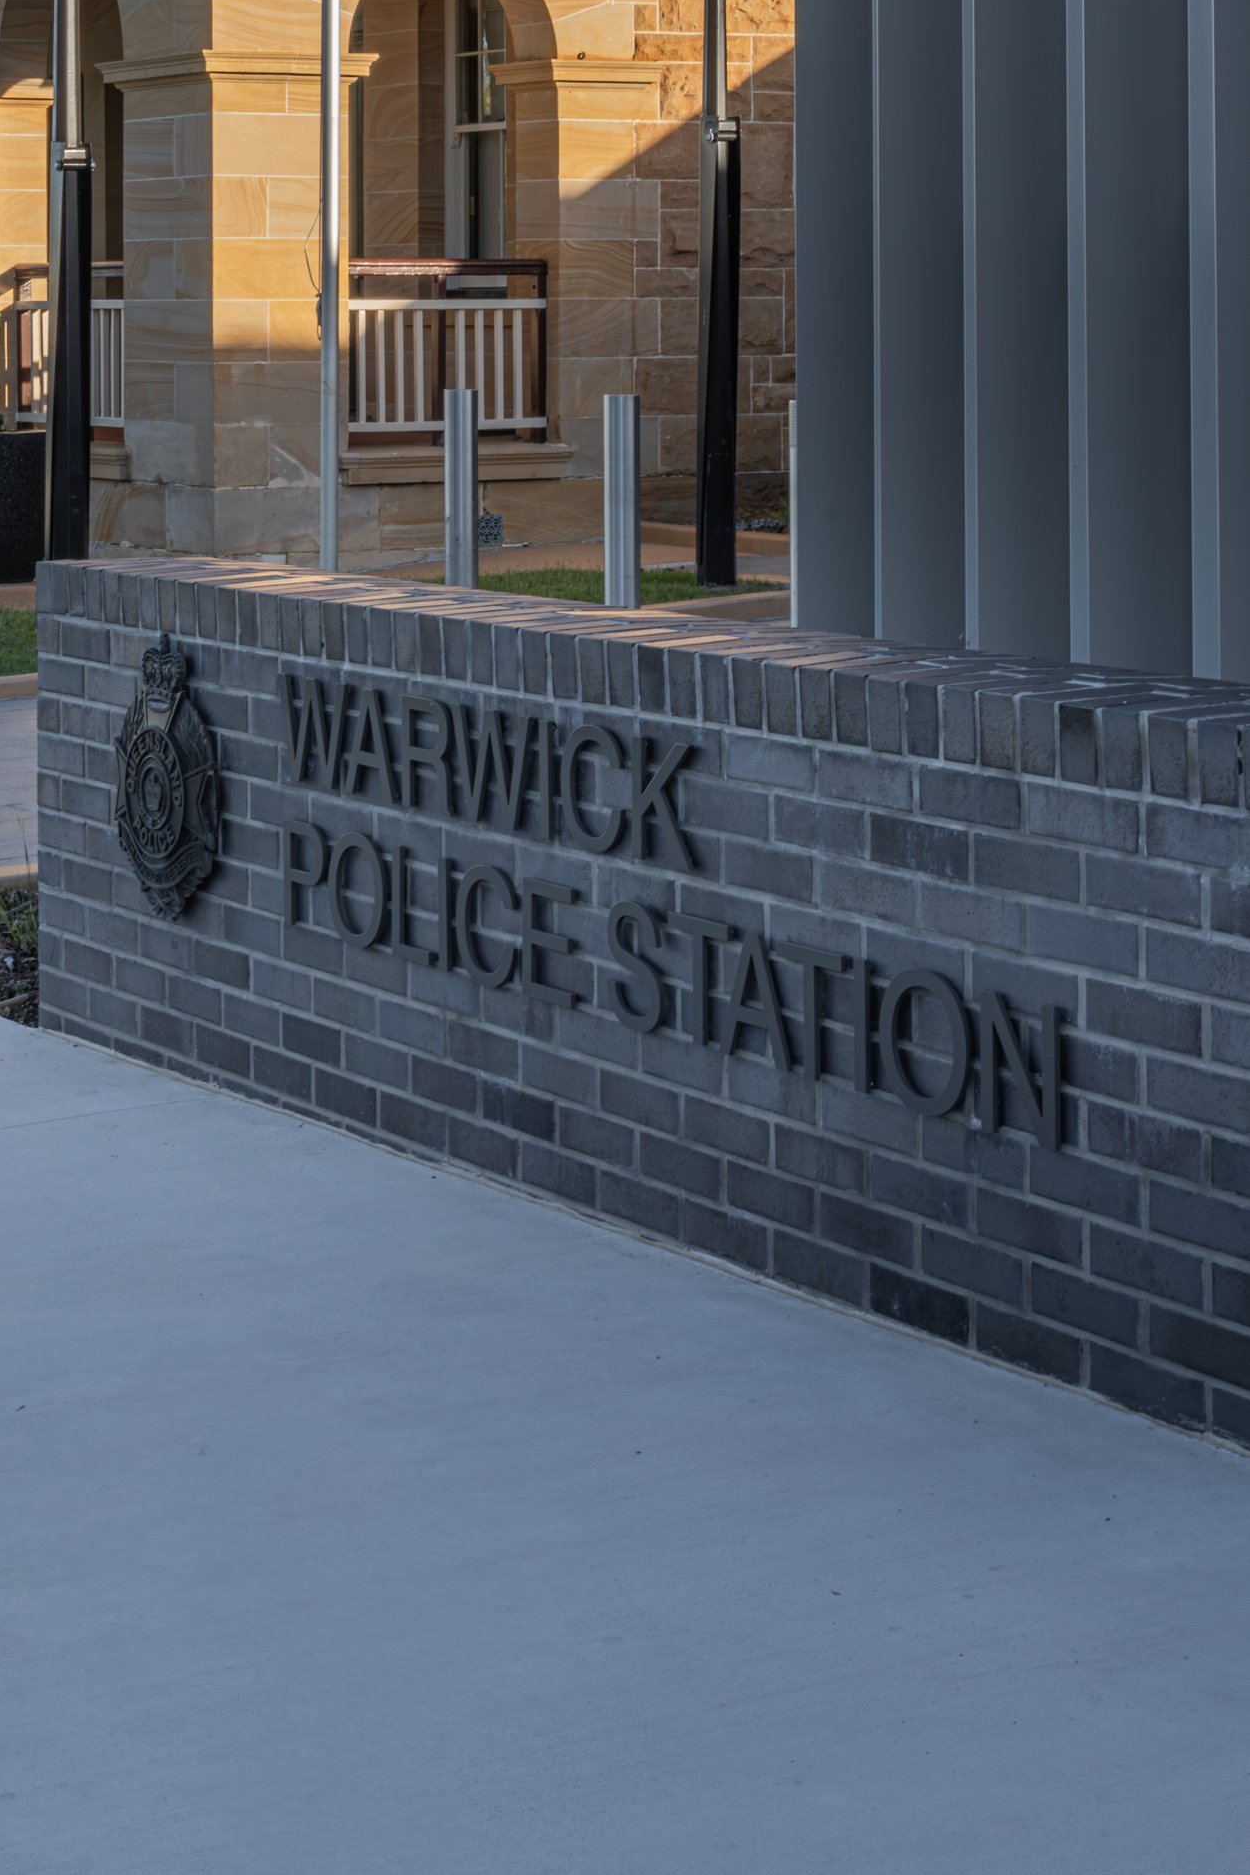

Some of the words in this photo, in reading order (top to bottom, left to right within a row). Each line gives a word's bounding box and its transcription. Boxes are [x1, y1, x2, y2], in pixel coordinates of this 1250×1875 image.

[126, 732, 181, 808] QUEENSLAND
[132, 818, 174, 854] POLICE
[278, 672, 694, 872] WARWICK
[283, 819, 578, 1009] POLICE
[607, 900, 1062, 1152] STATION
